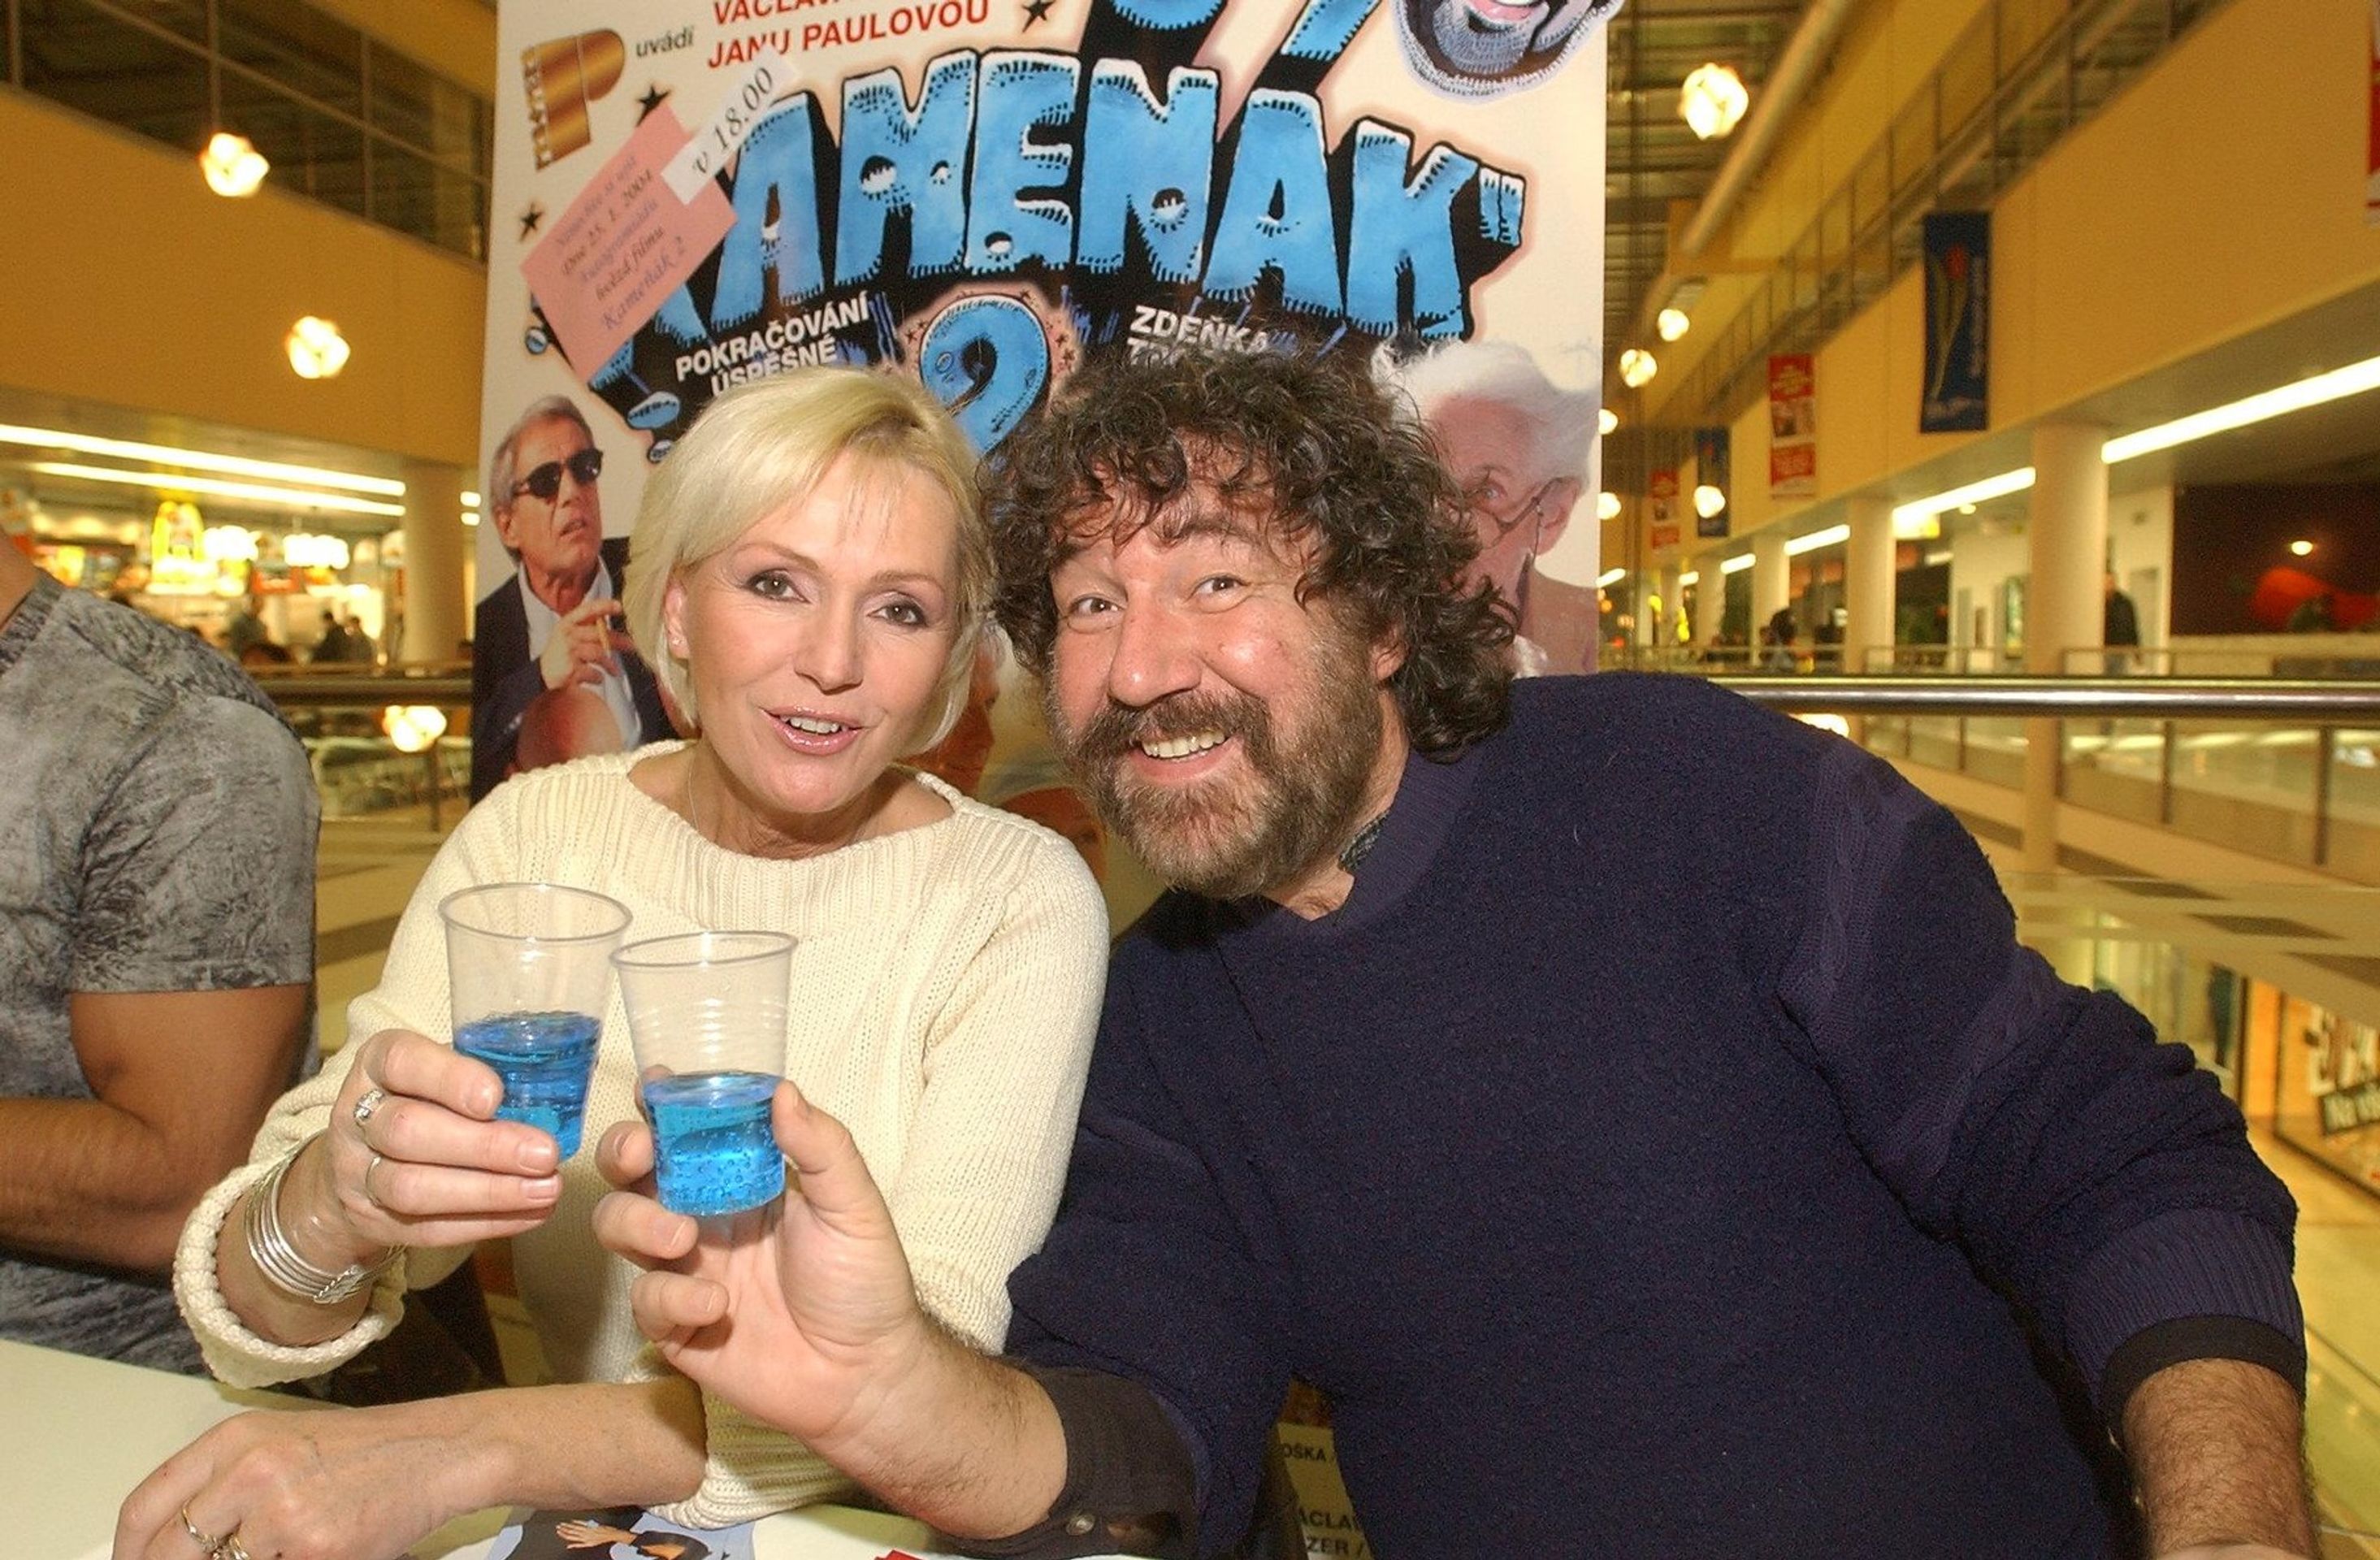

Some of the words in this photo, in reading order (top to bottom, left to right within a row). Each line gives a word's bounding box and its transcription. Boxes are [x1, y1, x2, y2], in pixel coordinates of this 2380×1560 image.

[636, 27, 694, 58] uvádí
[802, 0, 990, 50] PAULOVOU
[715, 67, 772, 149] 18.00
[675, 290, 869, 382] POKRAČOVÁNÍ
[1129, 305, 1270, 356] ZDEŇKA
[711, 333, 838, 396] ÚSPĚŠNÉ
[920, 293, 1051, 457] 2
